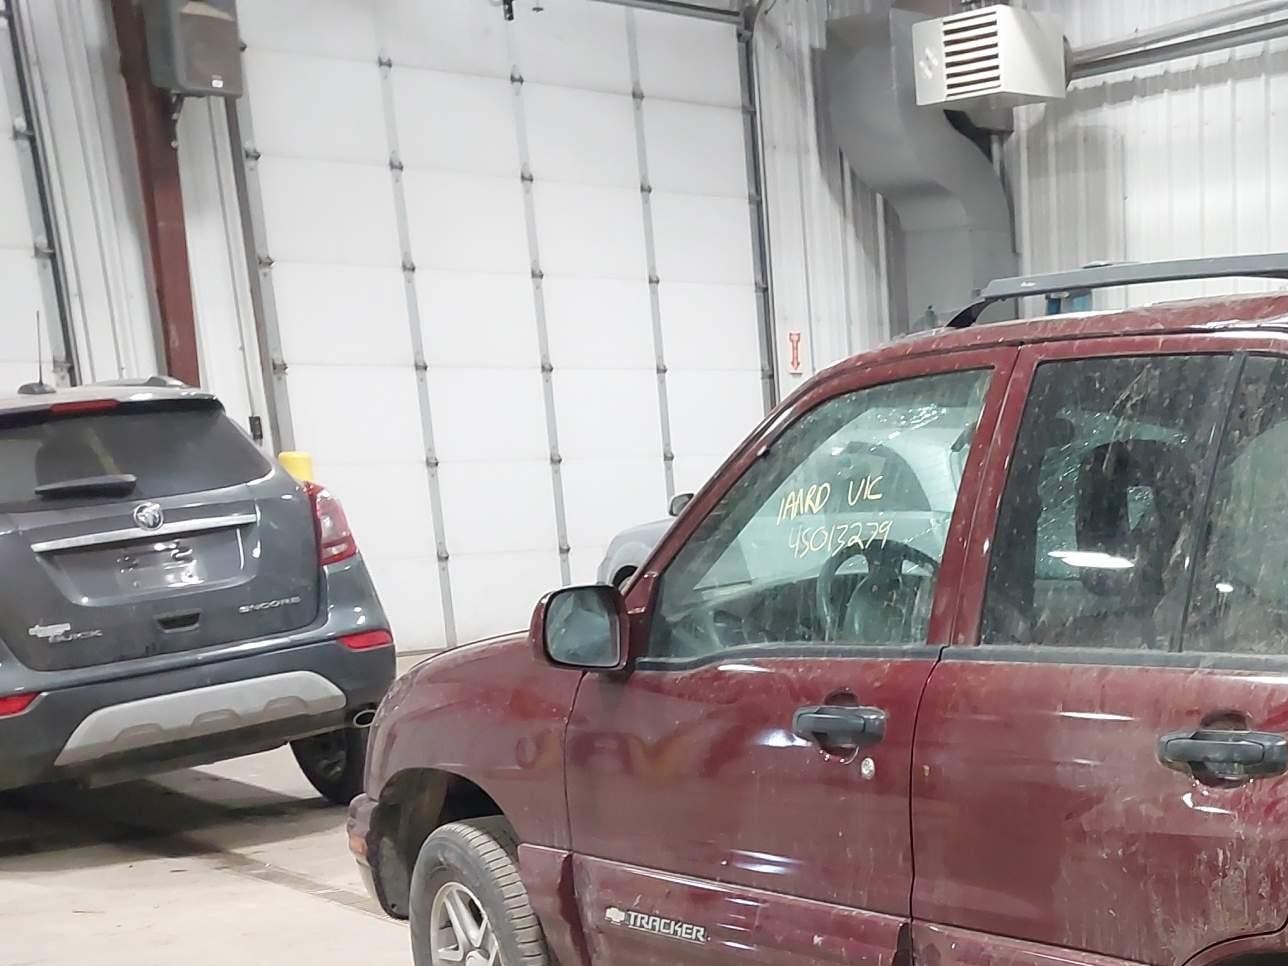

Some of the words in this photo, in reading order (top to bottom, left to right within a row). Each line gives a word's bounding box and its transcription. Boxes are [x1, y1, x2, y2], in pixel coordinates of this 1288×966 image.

[788, 520, 893, 559] 45013279
[238, 596, 303, 613] ENCORE
[626, 910, 706, 942] TRACKER
